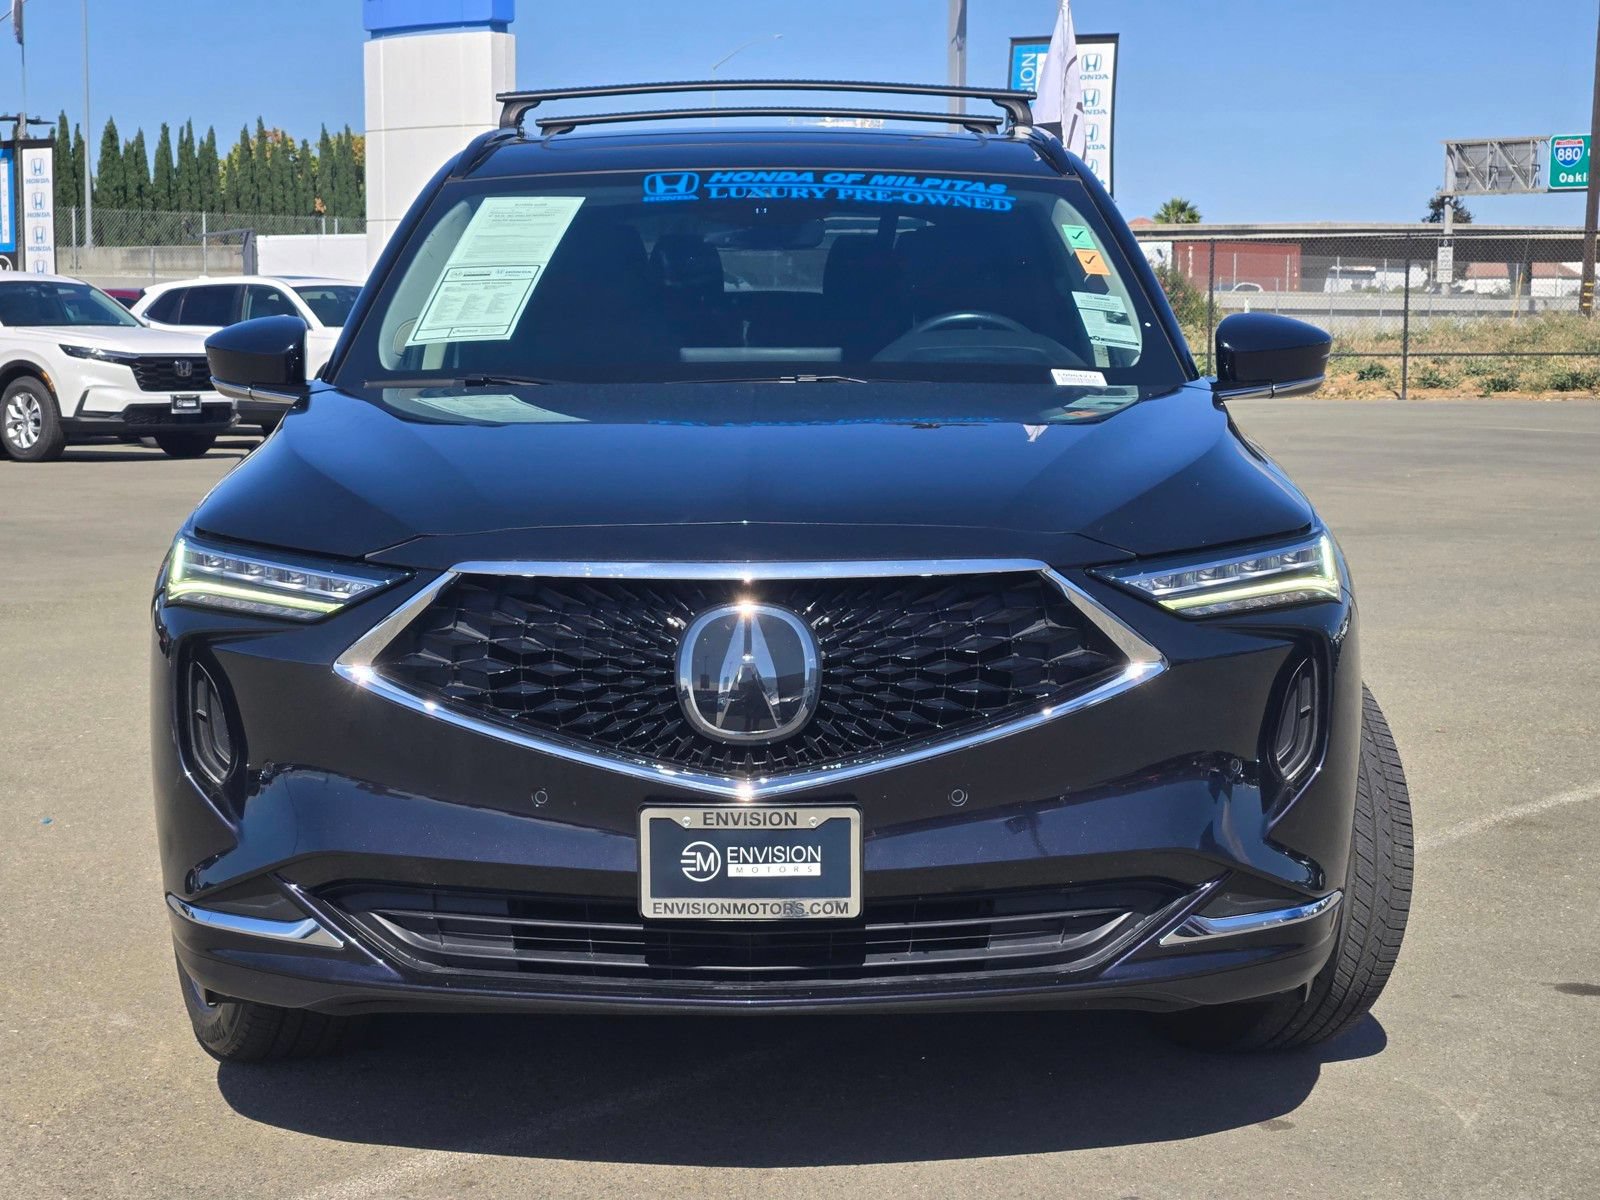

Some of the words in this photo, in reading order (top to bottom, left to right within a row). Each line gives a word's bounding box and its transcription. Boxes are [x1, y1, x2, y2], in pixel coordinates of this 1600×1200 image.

[1558, 148, 1580, 161] 880
[707, 171, 814, 183] HONDA
[822, 172, 866, 184] OF
[868, 174, 1008, 195] MILPITAS
[1559, 172, 1588, 183] Oakl
[707, 187, 828, 199] LUXURY
[836, 189, 1012, 211] PRE-OWNED
[702, 811, 797, 826] ENVISION
[727, 845, 821, 863] ENVISION
[735, 865, 814, 874] MOTORS
[652, 901, 850, 916] ENVISIONMOTORS.COM
